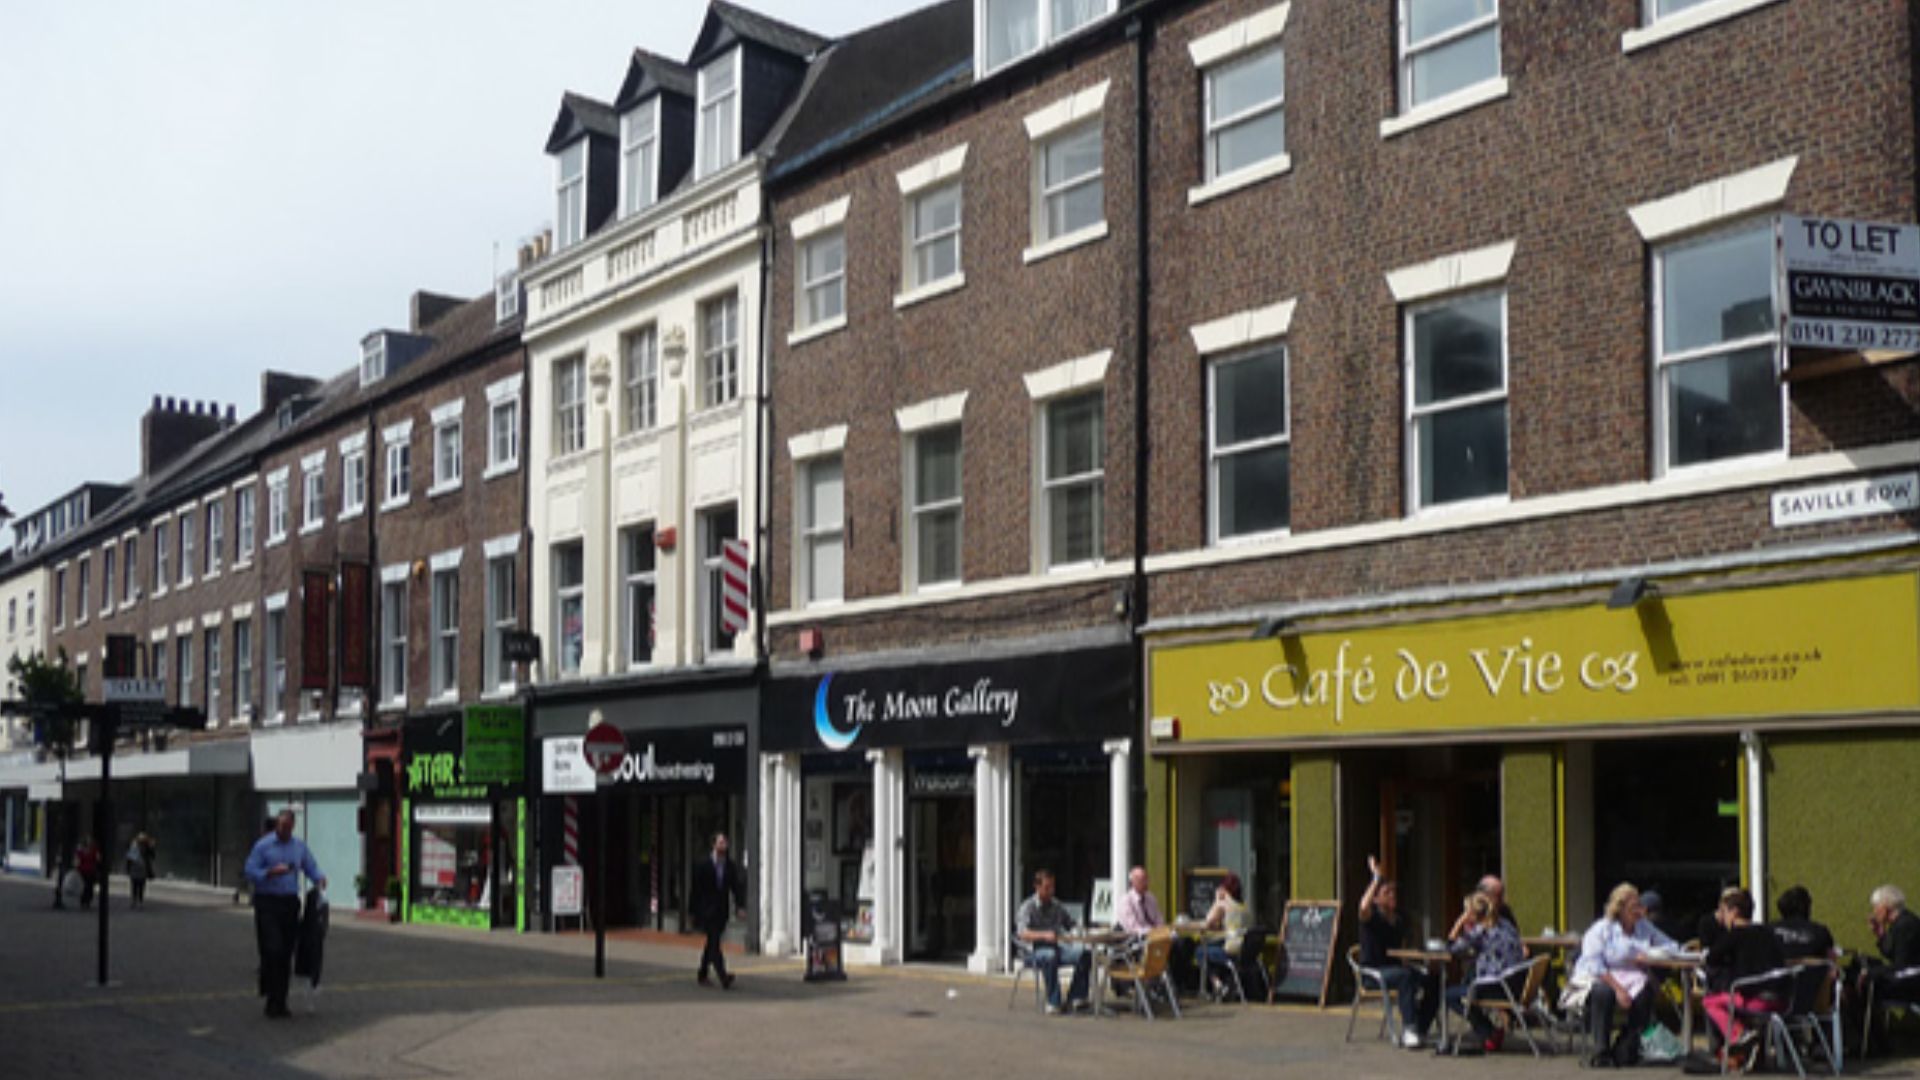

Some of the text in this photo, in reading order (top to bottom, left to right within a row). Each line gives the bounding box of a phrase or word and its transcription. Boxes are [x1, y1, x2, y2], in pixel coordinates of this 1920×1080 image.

[1802, 220, 1901, 255] TO LET
[1792, 322, 1834, 343] 0191
[1842, 325, 1875, 346] 230
[1780, 481, 1911, 516] SAVILLE ROW
[1261, 638, 1564, 724] Café de Vie
[843, 677, 1018, 727] The Moon Gallery
[612, 743, 655, 782] oul
